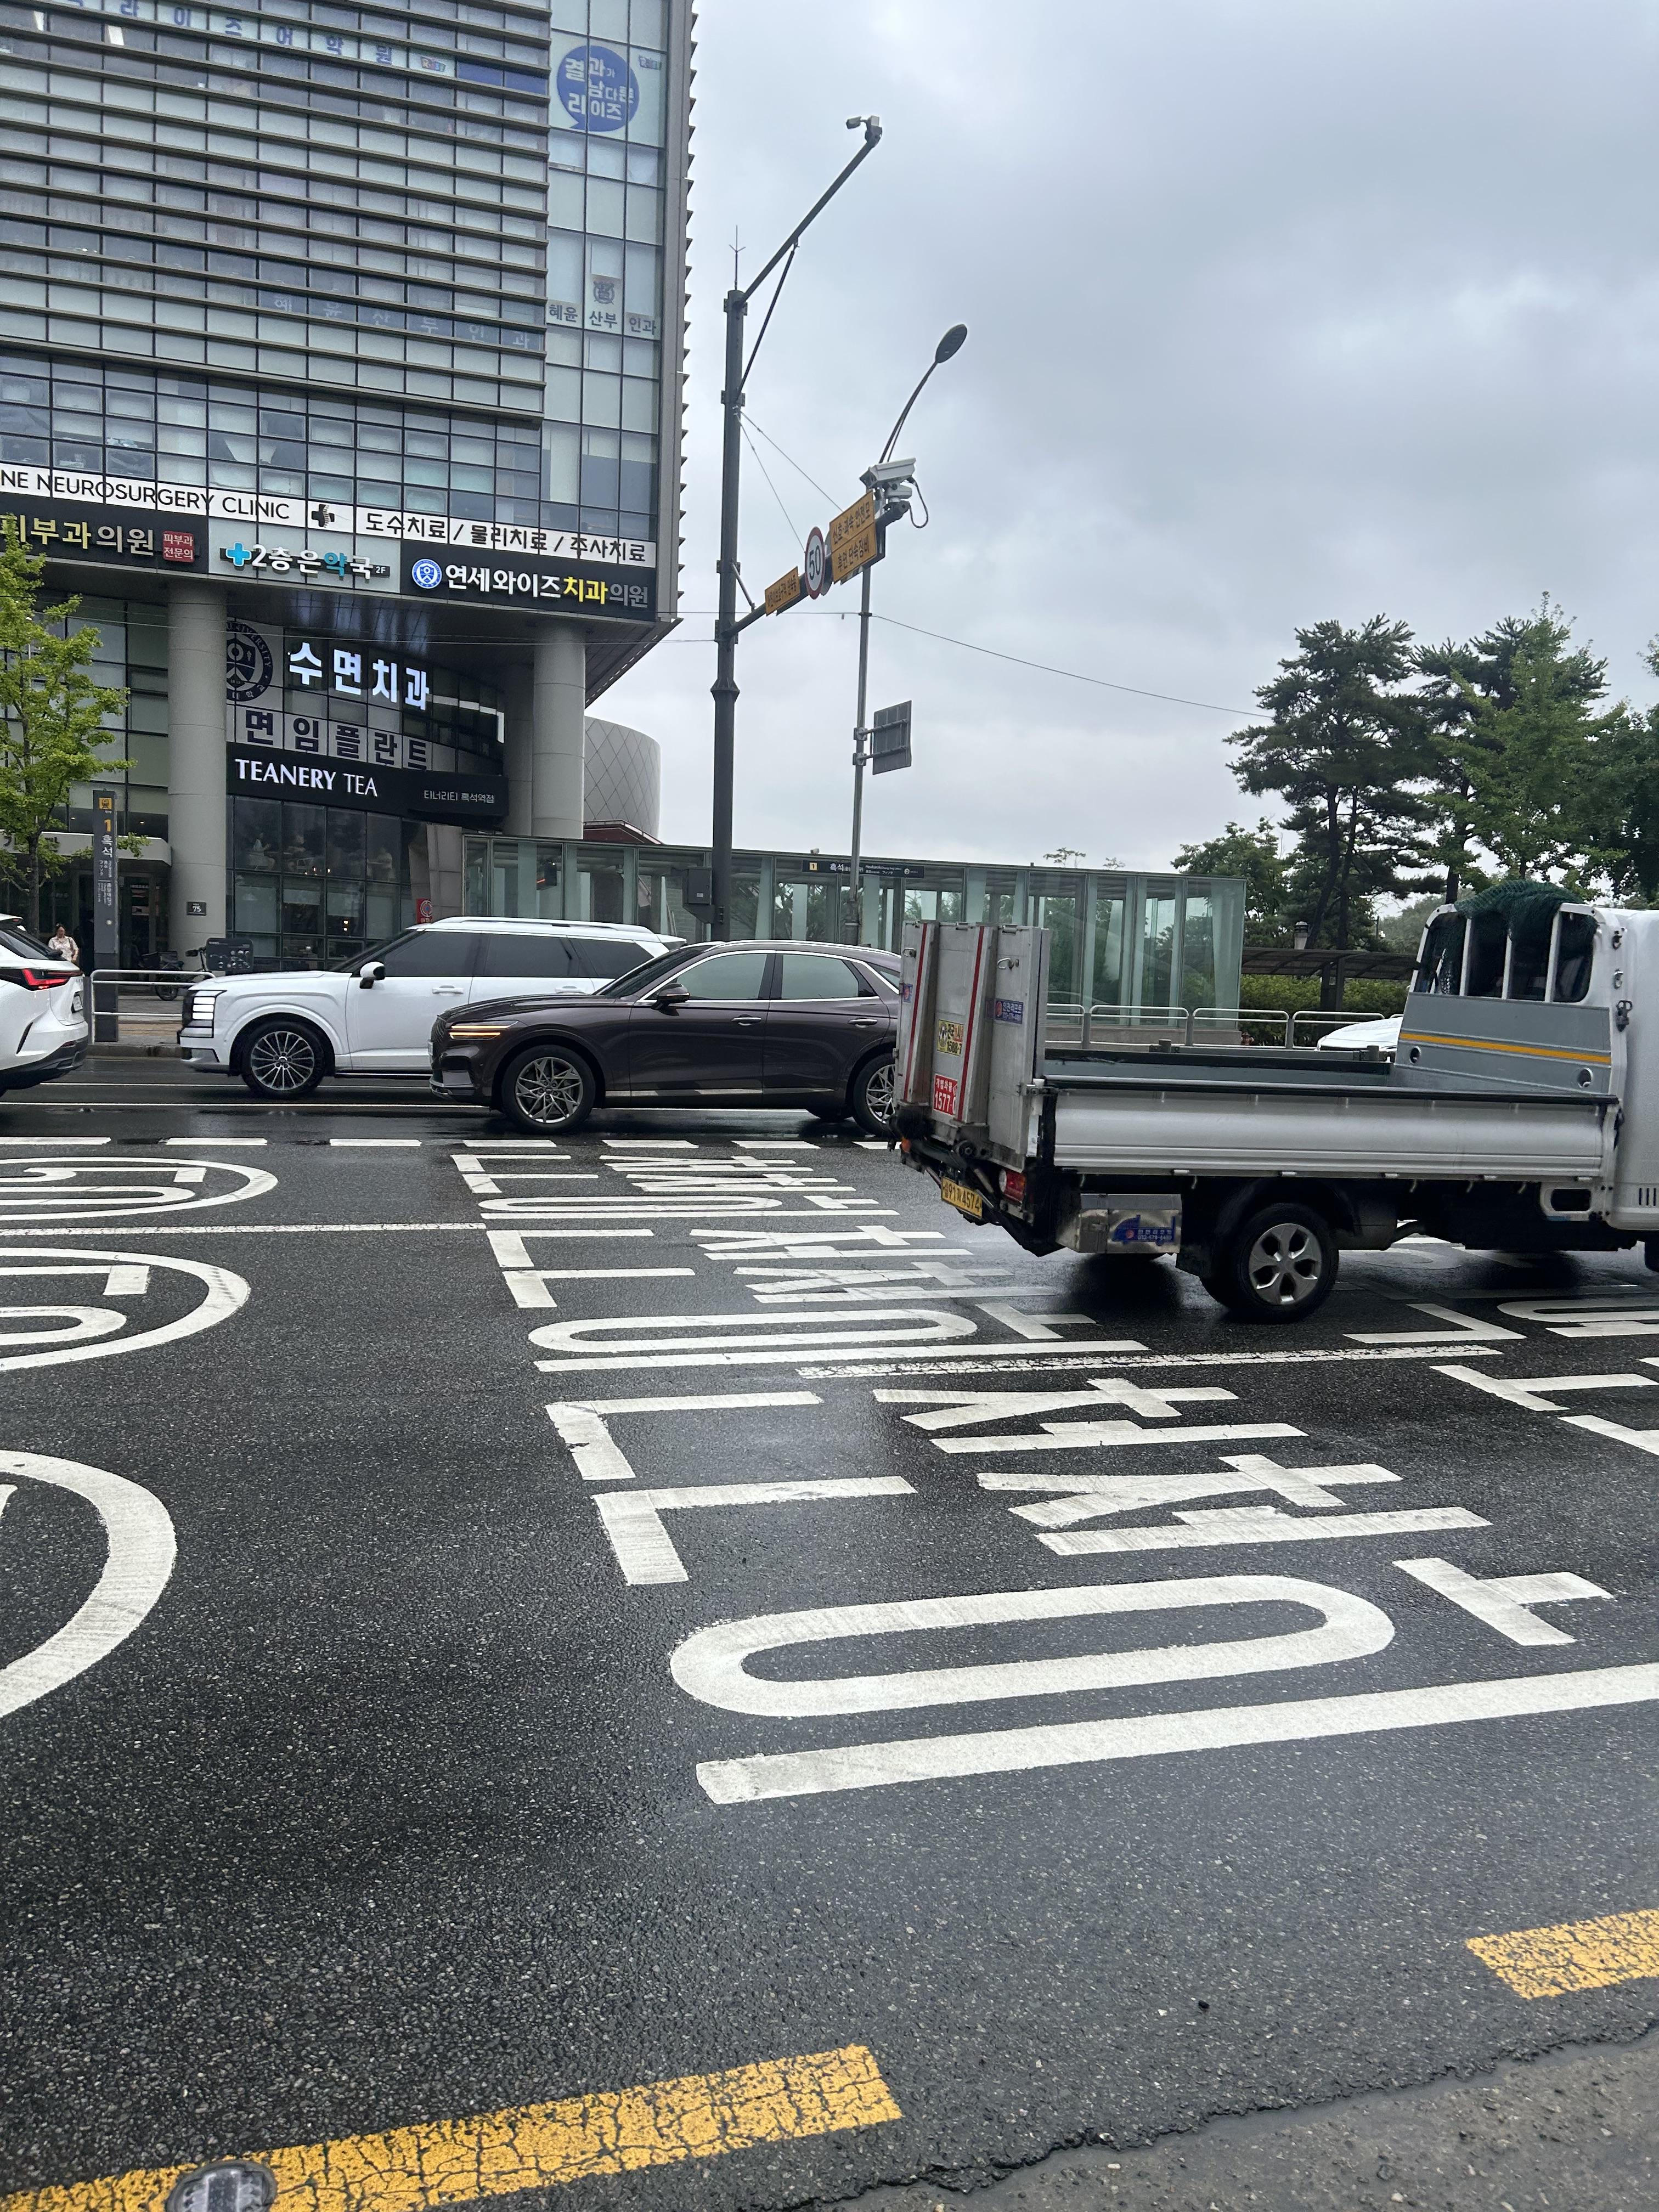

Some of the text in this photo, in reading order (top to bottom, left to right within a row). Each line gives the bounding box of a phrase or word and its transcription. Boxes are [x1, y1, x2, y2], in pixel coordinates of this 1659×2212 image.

[37, 473, 214, 510] NEUROSURGERY
[222, 496, 290, 520] CLINIC
[163, 533, 194, 546] 피부과
[163, 546, 194, 561] 전문의
[365, 512, 446, 539] 도수치료
[471, 525, 547, 550] 물리치료
[570, 536, 646, 562] 주사치료
[251, 544, 386, 580] 2층은약국 2F
[809, 545, 821, 580] 50
[289, 642, 430, 710] 수면치과
[234, 758, 378, 798] TEANERY TEA
[104, 819, 111, 832] 1
[101, 834, 114, 857] 흑석
[830, 862, 844, 872] 흑석
